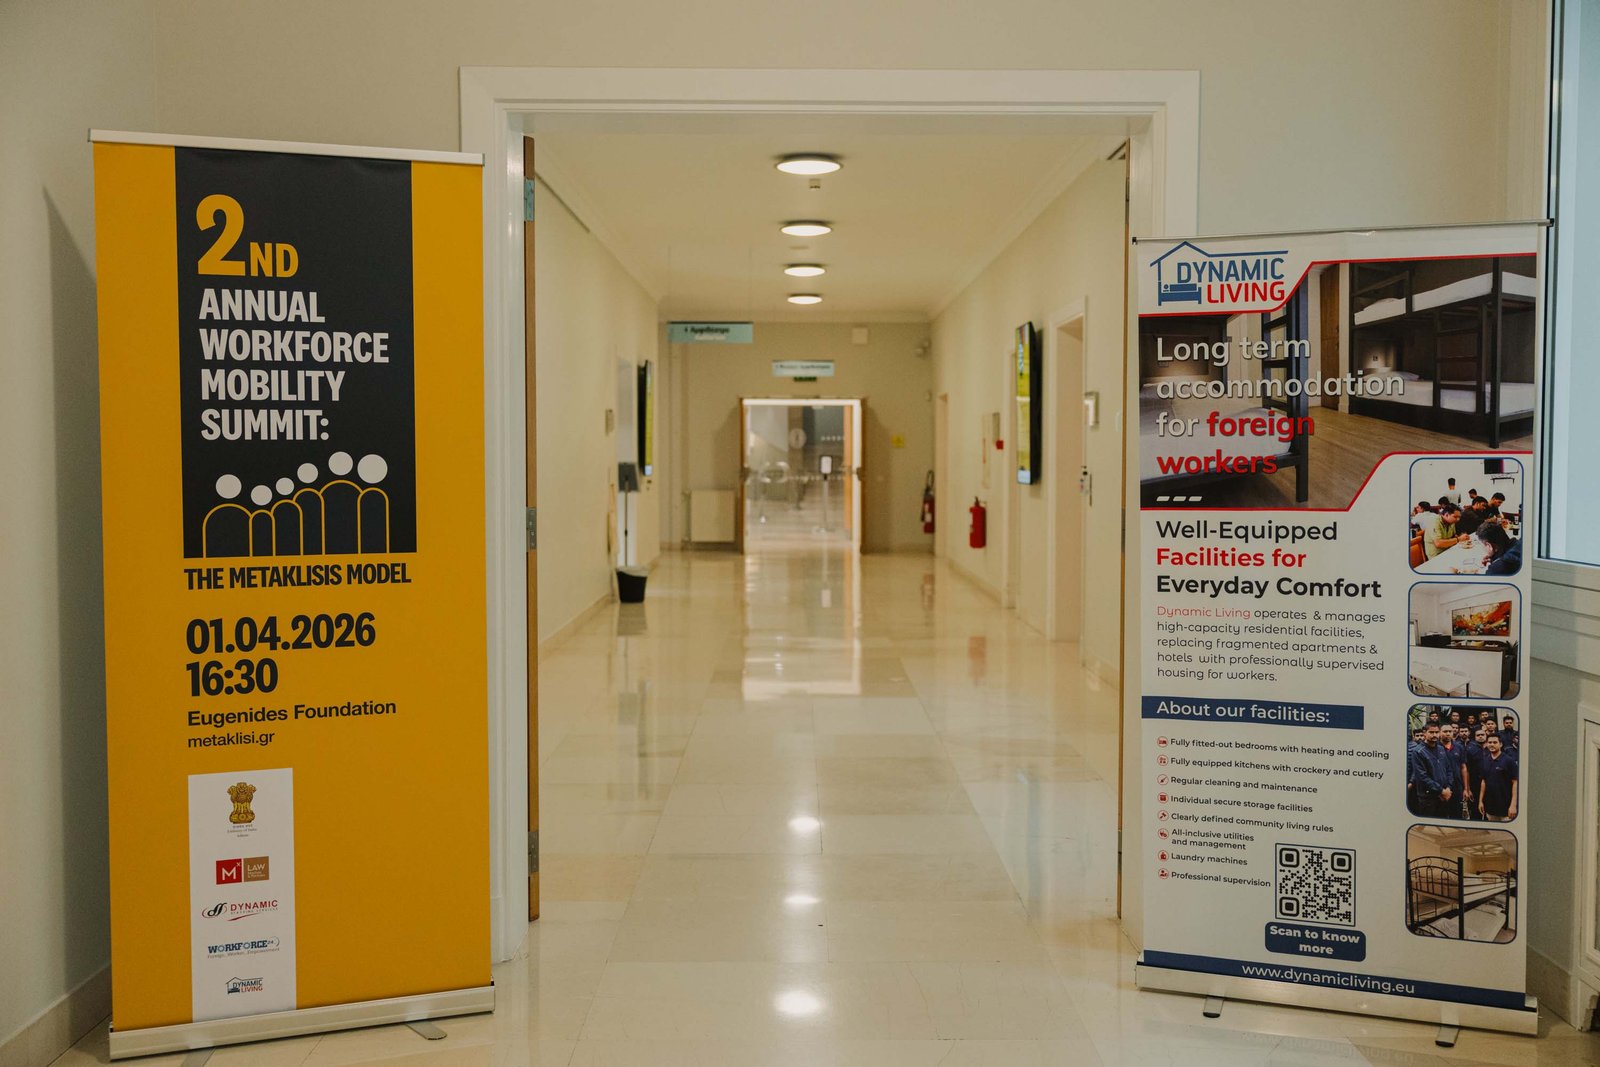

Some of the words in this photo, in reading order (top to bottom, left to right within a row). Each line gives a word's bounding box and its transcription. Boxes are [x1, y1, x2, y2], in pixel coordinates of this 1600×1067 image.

[1177, 257, 1284, 284] DYNAMIC
[1207, 281, 1286, 303] LIVING
[199, 288, 325, 323] ANNUAL
[199, 329, 389, 364] WORKFORCE
[1156, 337, 1231, 365] Long
[1239, 337, 1311, 360] term
[201, 369, 345, 401] MOBILITY
[1155, 370, 1406, 400] accommodation
[201, 408, 329, 441] SUMMIT:
[1155, 412, 1200, 438] for
[1206, 411, 1315, 441] foreign
[1156, 449, 1278, 475] workers
[1156, 520, 1337, 544] Well-Equipped
[1157, 547, 1265, 567] Facilities
[1272, 548, 1307, 567] for
[184, 568, 224, 590] THE
[229, 564, 342, 588] METAKLISIS
[347, 563, 411, 585] MODEL
[1157, 575, 1269, 599] Everyday
[1276, 577, 1382, 598] Comfort
[1157, 606, 1212, 618] Dynamic
[1215, 608, 1251, 620] Living
[1254, 610, 1307, 623] operates
[1313, 610, 1321, 620] &
[1325, 613, 1385, 624] manages
[186, 612, 376, 654] 01.04.2026
[1157, 621, 1240, 635] high-capacity
[1244, 624, 1308, 636] residential
[1311, 626, 1364, 639] facilities,
[1157, 637, 1213, 650] replacing
[1216, 638, 1289, 651] fragmented
[1292, 643, 1366, 654] apartments
[1369, 644, 1378, 654] &
[1157, 652, 1193, 663] hotels
[1199, 653, 1226, 664] with
[1229, 654, 1313, 670] professionally
[1317, 659, 1384, 671] supervised
[186, 658, 278, 697] 16:30
[1157, 667, 1204, 681] housing
[1208, 669, 1223, 679] for
[1226, 670, 1277, 681] workers.
[188, 707, 288, 728] Eugenides
[294, 700, 396, 719] Foundation
[1156, 701, 1210, 716] About
[1216, 706, 1246, 717] our
[1250, 704, 1329, 723] facilities:
[188, 731, 275, 748] metaklisi.gr
[1171, 738, 1190, 748] Fully
[1192, 739, 1233, 748] fitted-out
[1235, 741, 1278, 751] bedrooms
[1279, 745, 1299, 753] with
[1301, 746, 1335, 757] heating
[1356, 750, 1389, 760] cooling
[1171, 757, 1190, 767] Fully
[1192, 760, 1232, 768] equipped
[1234, 760, 1270, 770] kitchens
[1272, 764, 1291, 772] with
[1293, 766, 1331, 776] crockery
[1352, 770, 1384, 780] cutlery
[1171, 776, 1203, 786] Regular
[1205, 779, 1241, 789] cleaning
[1261, 783, 1318, 793] maintenance
[1171, 796, 1212, 804] Individual
[1243, 801, 1275, 811] storage
[1277, 803, 1313, 813] facilities
[1171, 813, 1199, 823] Clearly
[1201, 815, 1234, 824] defined
[1235, 818, 1284, 830] community
[1286, 822, 1310, 832] living
[1312, 824, 1334, 832] rules
[1171, 829, 1222, 838] All-inclusive
[1223, 832, 1254, 841] utilities
[1189, 840, 1246, 850] management
[248, 863, 265, 871] LAW
[1171, 853, 1205, 863] Laundry
[1207, 856, 1248, 865] machines
[1171, 871, 1221, 882] Professional
[1223, 877, 1271, 887] supervision
[230, 900, 278, 911] DYNAMIC
[1270, 925, 1301, 937] Scan
[1304, 929, 1319, 939] to
[1322, 930, 1360, 943] know
[1299, 944, 1334, 954] more
[232, 980, 263, 988] DYNAMIC
[1242, 965, 1415, 994] www.dynamicliving.eu
